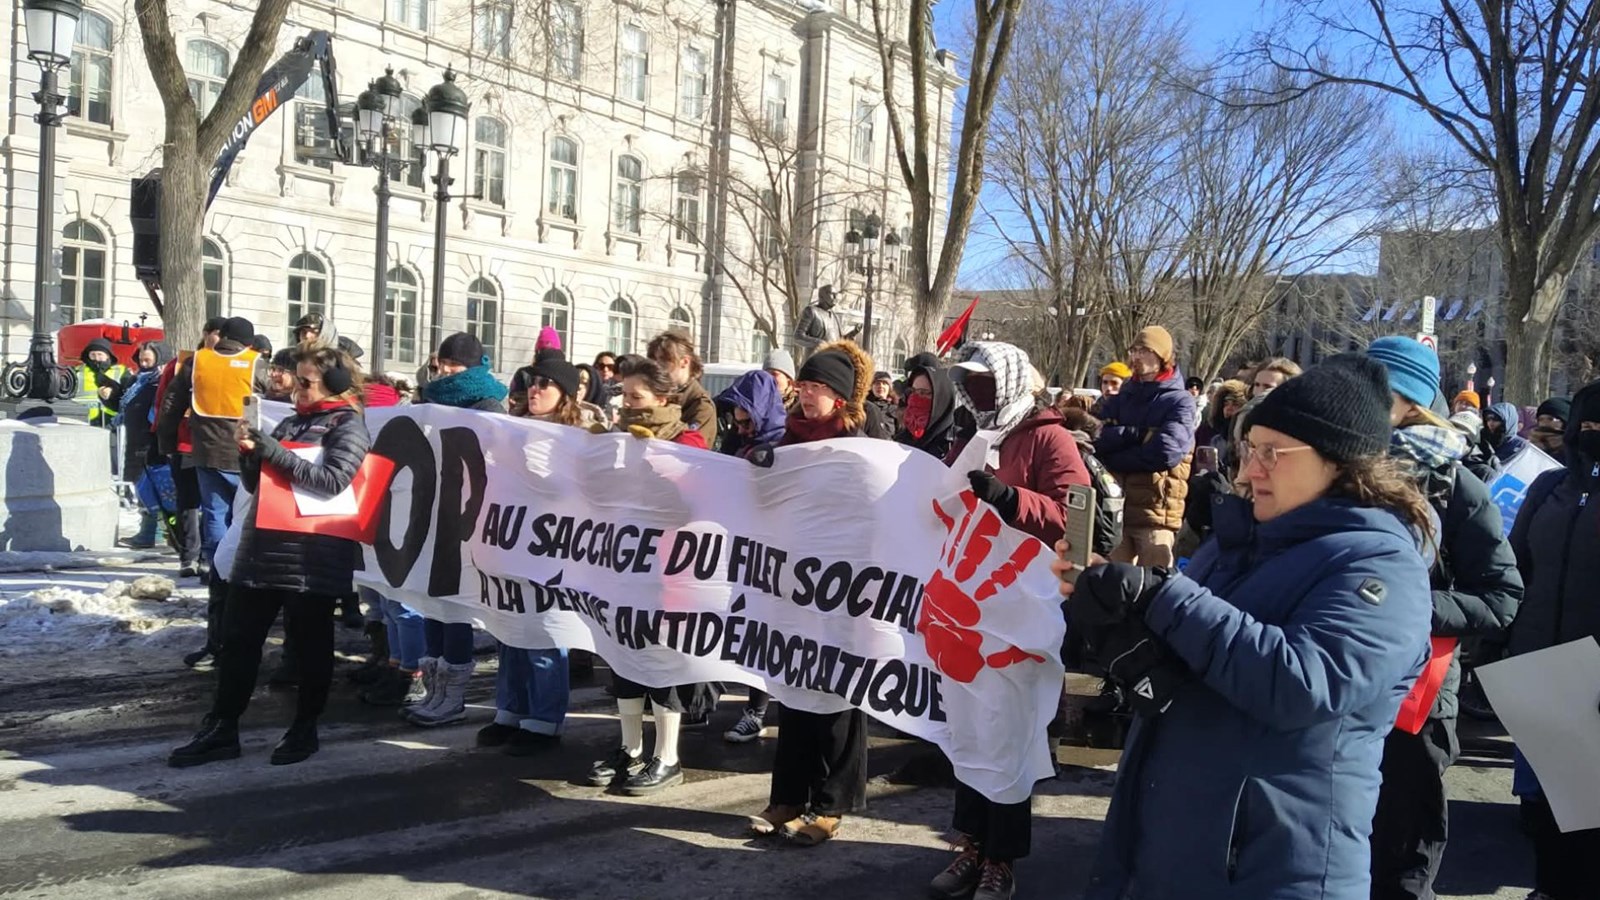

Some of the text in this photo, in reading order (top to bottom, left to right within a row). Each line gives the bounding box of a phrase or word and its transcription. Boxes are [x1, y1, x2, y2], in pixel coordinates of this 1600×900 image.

[252, 87, 278, 125] GM
[363, 415, 488, 597] OP
[481, 502, 527, 550] AU
[527, 513, 664, 573] SACCAGE
[664, 530, 723, 580] DU
[727, 535, 787, 598] FILET
[489, 575, 526, 614] LA
[614, 593, 948, 722] ANTIDÉMOCRATIQUE
